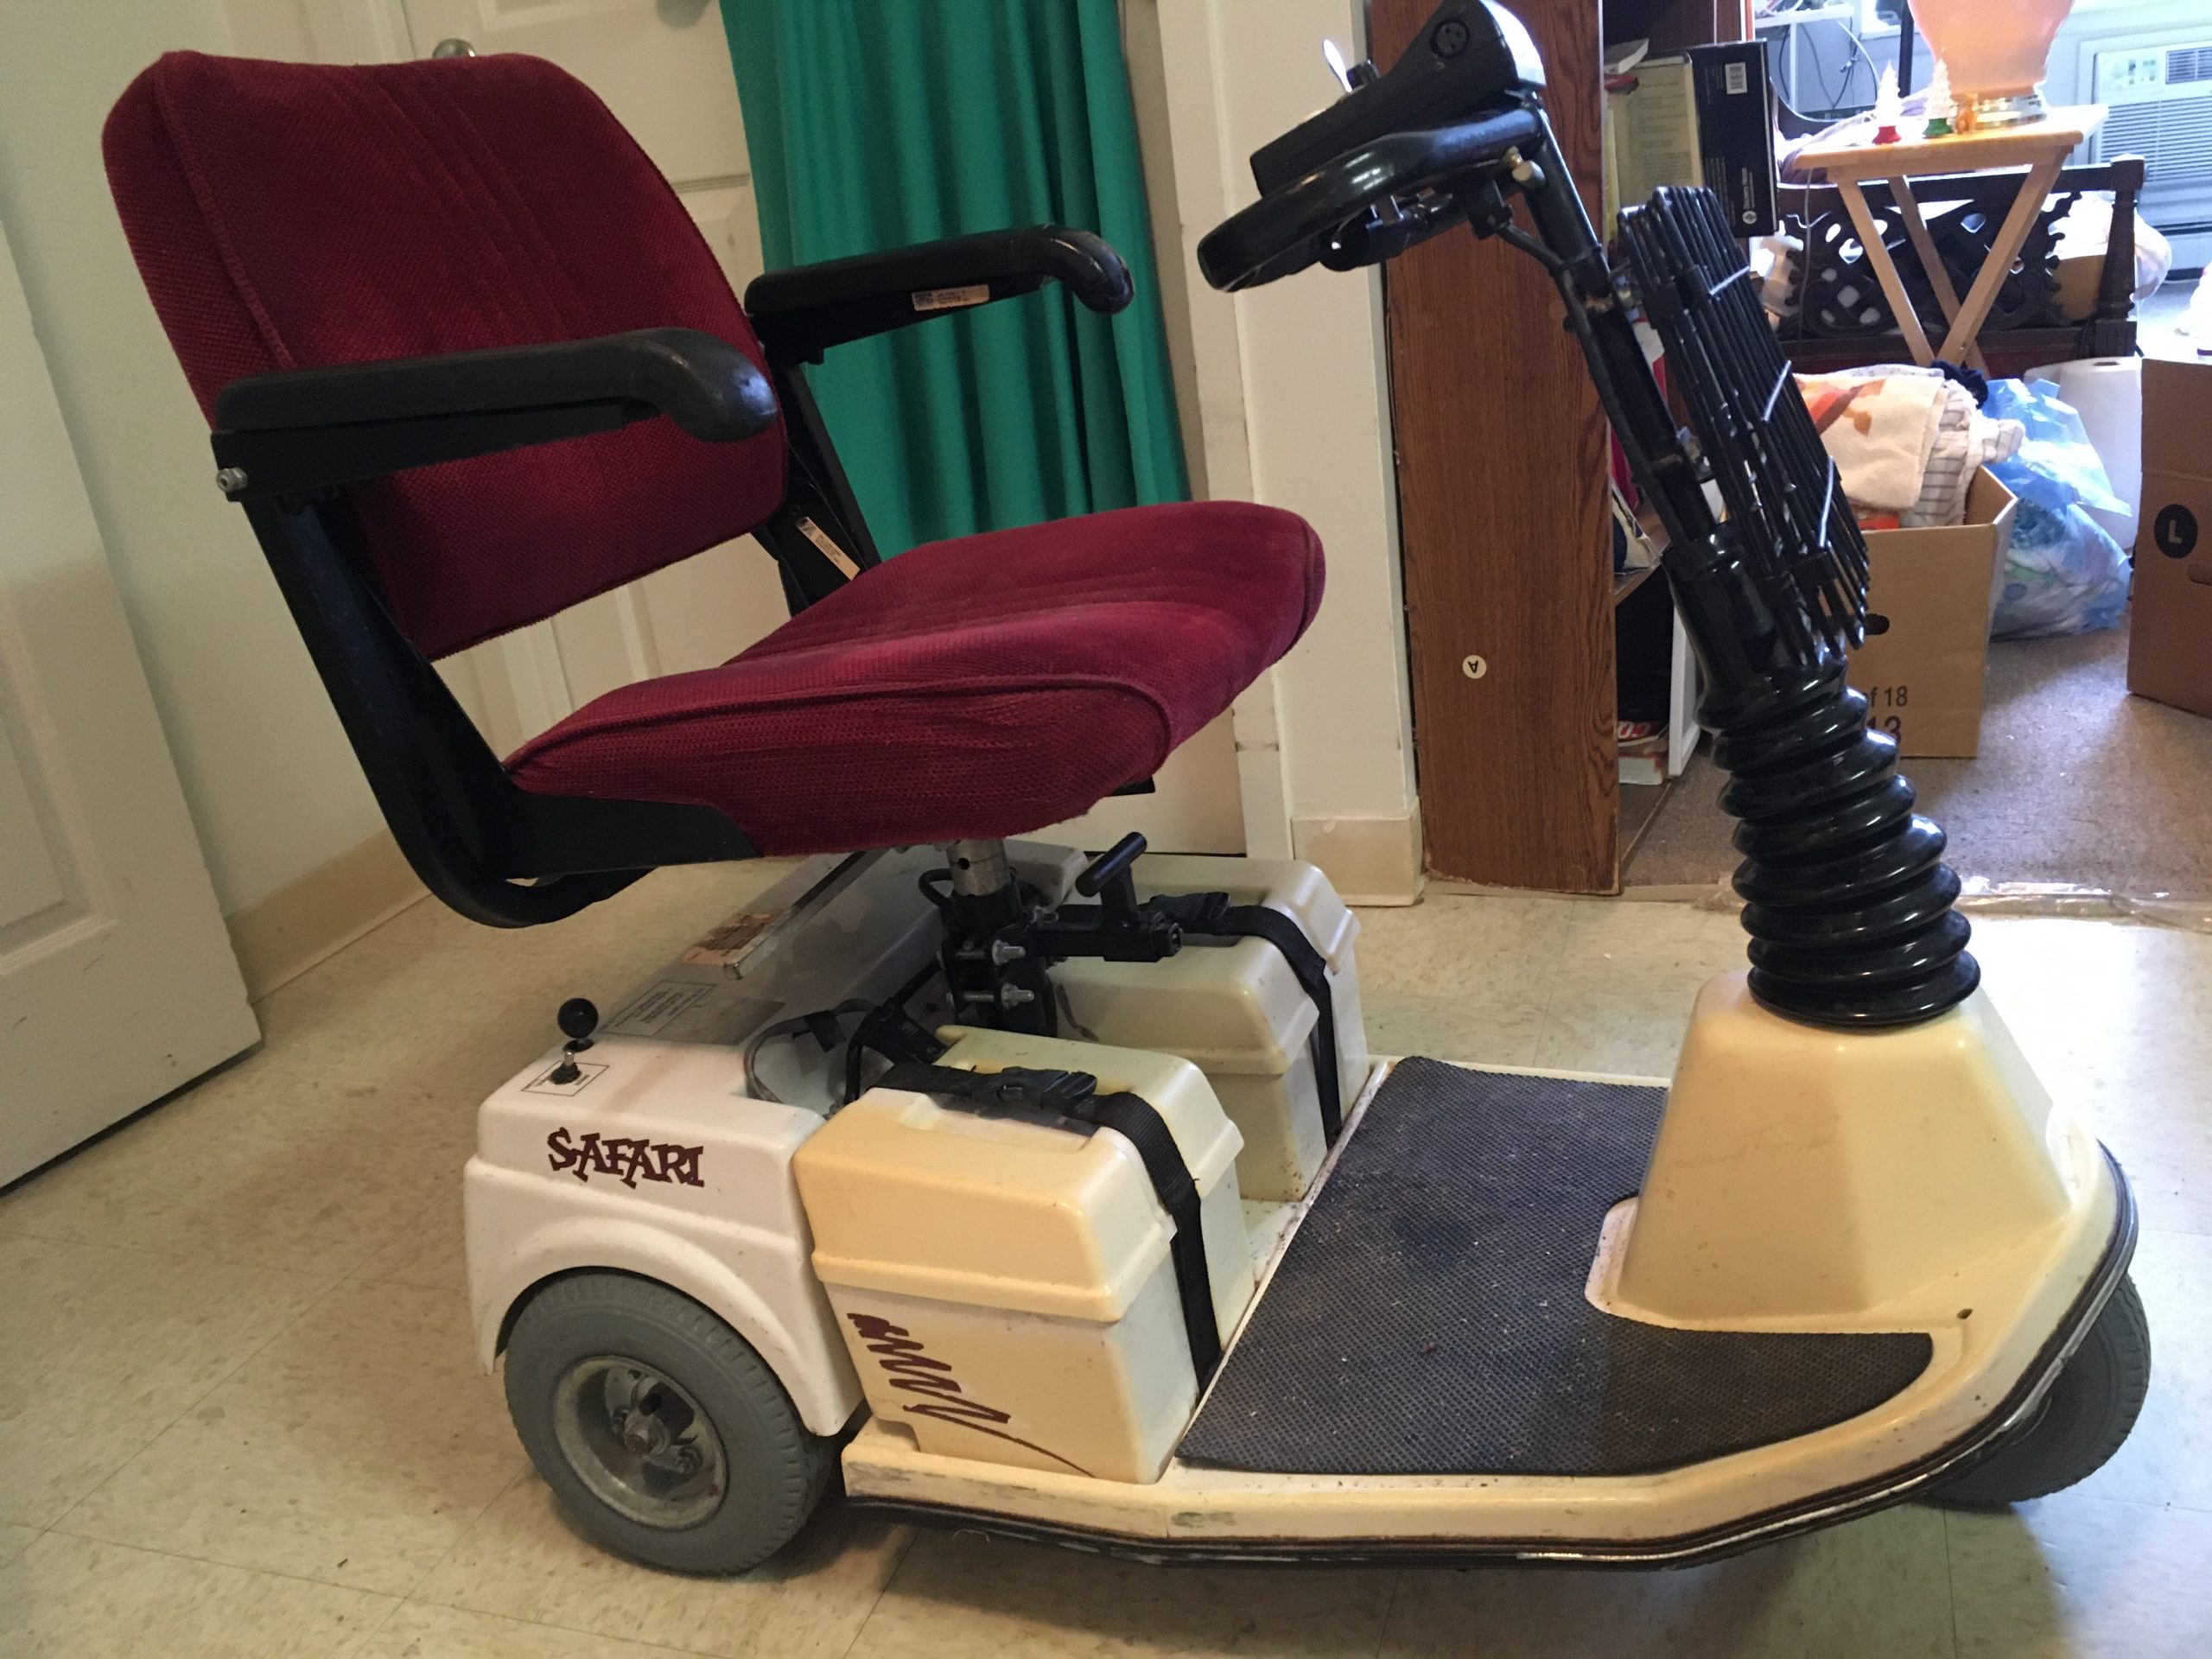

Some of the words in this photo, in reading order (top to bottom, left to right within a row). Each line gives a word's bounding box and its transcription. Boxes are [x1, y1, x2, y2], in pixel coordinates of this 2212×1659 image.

[2168, 519, 2183, 544] L
[1467, 659, 1479, 674] A
[1884, 684, 1908, 708] 18
[547, 1127, 704, 1190] SAFARI
